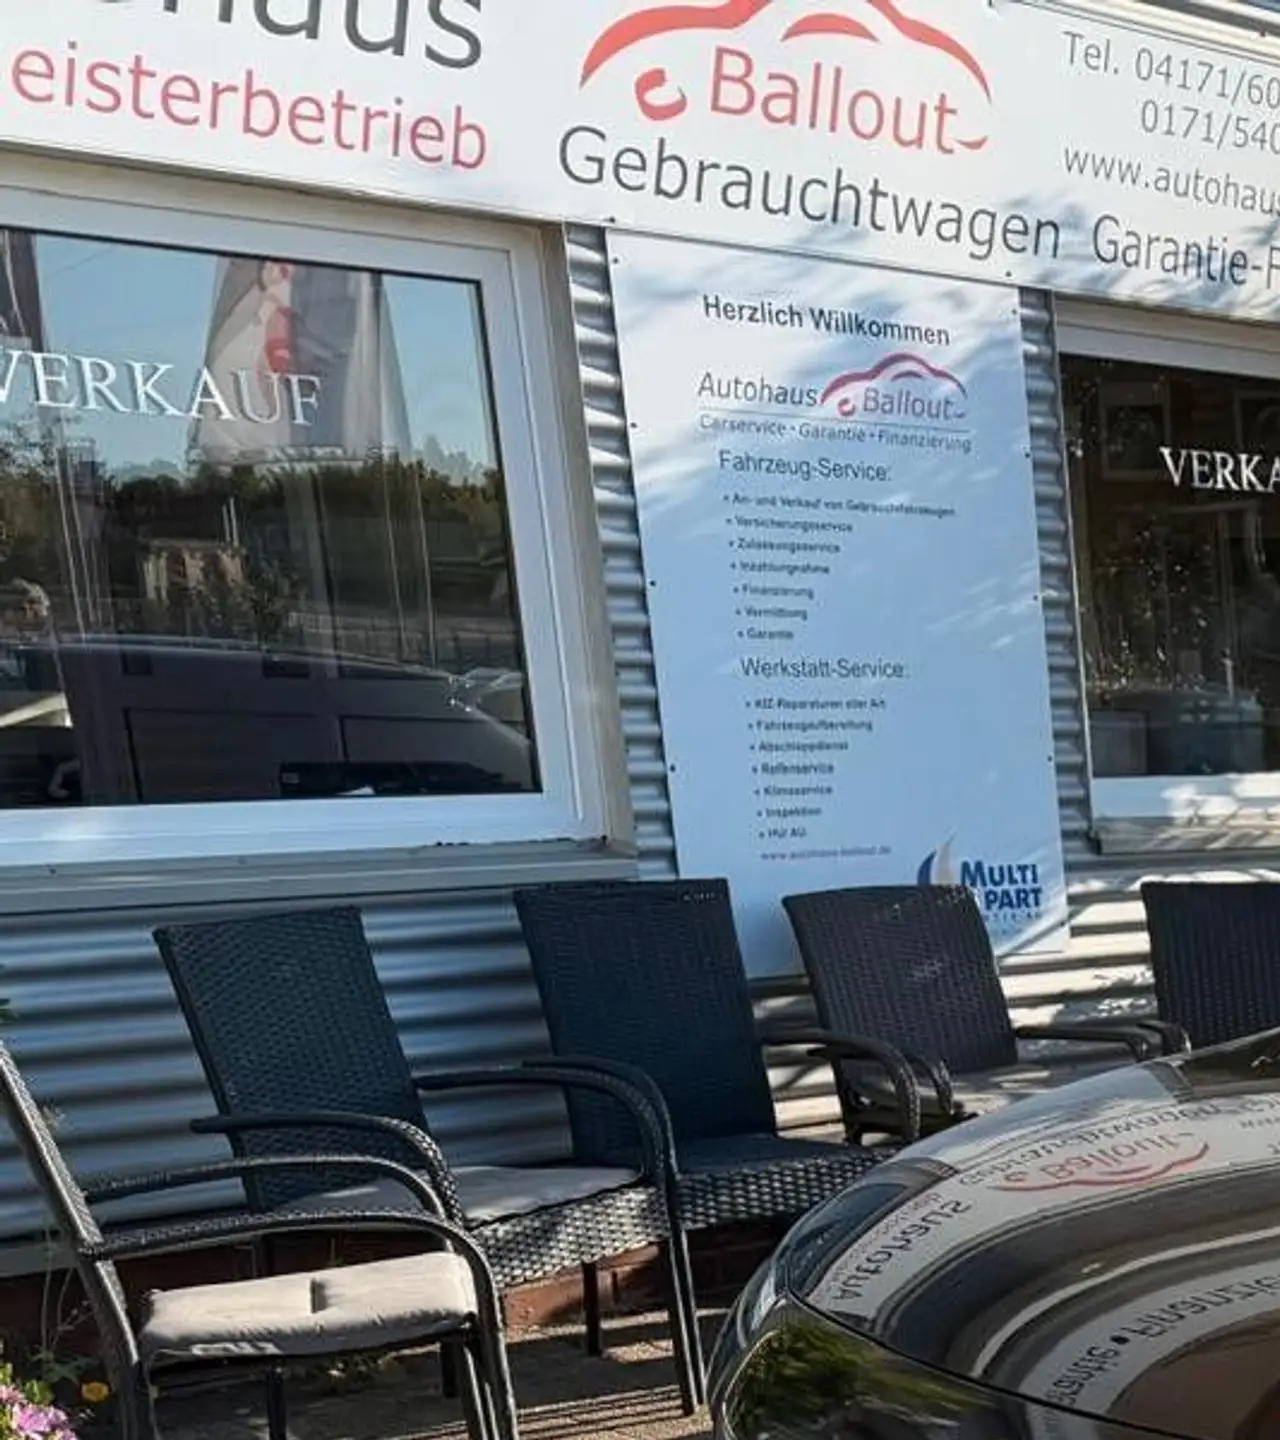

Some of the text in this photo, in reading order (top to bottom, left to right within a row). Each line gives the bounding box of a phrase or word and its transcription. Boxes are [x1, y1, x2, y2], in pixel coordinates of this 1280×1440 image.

[1063, 31, 1119, 75] Tel.
[11, 40, 488, 170] eisterbetrieb
[709, 46, 958, 155] Ballout
[559, 125, 1061, 261] Gebrauchtwagen
[703, 294, 951, 347] Herzlich Willkommen
[698, 371, 957, 422] Autohaus Ballout
[700, 413, 973, 455] Carservice Garantie Finanzierung
[718, 450, 892, 482] Fahrzeug-Service:
[960, 859, 1038, 887] MULTI
[983, 887, 1043, 911] PART
